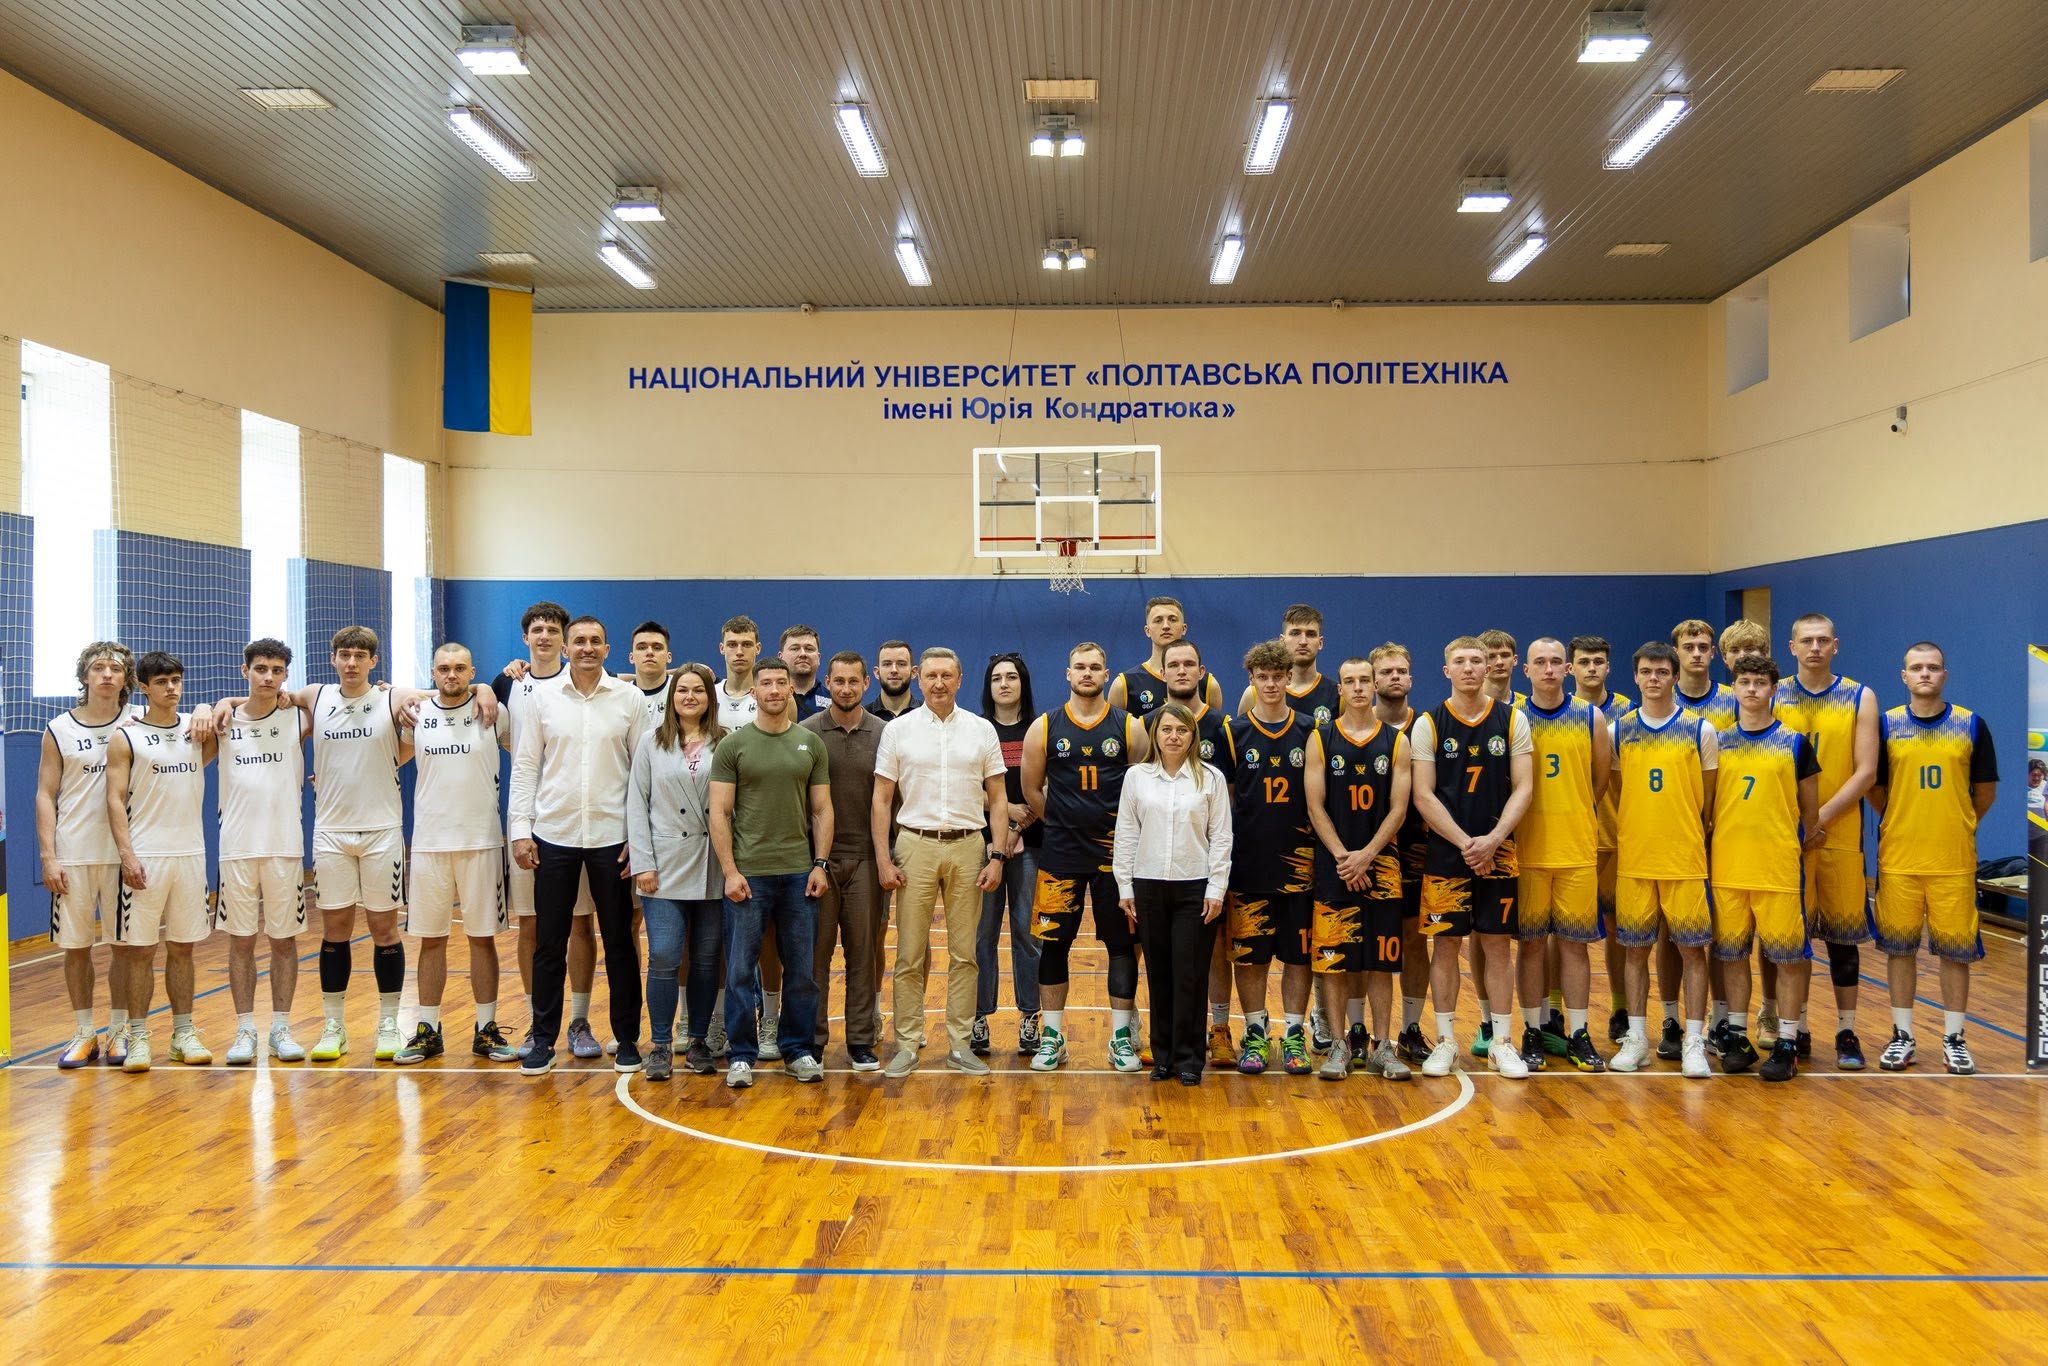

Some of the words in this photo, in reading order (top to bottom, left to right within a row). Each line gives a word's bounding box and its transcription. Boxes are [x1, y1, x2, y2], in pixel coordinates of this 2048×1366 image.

[629, 360, 865, 393] НАЦІОНАЛЬНИЙ
[874, 364, 1076, 388] УНІВЕРСИТЕТ
[1086, 362, 1303, 386] «ПОЛТАВСЬКА
[1312, 361, 1509, 384] ПОЛІТЕХНІКА
[883, 398, 952, 420] імені
[962, 397, 1032, 424] Юрія
[1045, 397, 1236, 423] Кондратюка»
[328, 706, 337, 717] 7
[423, 718, 438, 729] 58
[77, 738, 93, 751] 13
[145, 734, 160, 746] 19
[230, 728, 243, 740] 11
[324, 727, 373, 741] SumDU
[235, 752, 283, 766] SumDU
[424, 743, 471, 756] SumDU
[152, 762, 198, 775] SumDU
[1078, 765, 1098, 790] 11
[1546, 753, 1560, 778] 3
[1920, 765, 1942, 790] 10
[1263, 776, 1290, 803] 12
[1466, 766, 1483, 793] 7
[1649, 768, 1663, 792] 8
[1742, 776, 1756, 800] 7
[1348, 784, 1374, 810] 10
[1500, 898, 1514, 923] 7
[1299, 928, 1313, 954] 1
[1377, 935, 1400, 962] 10
